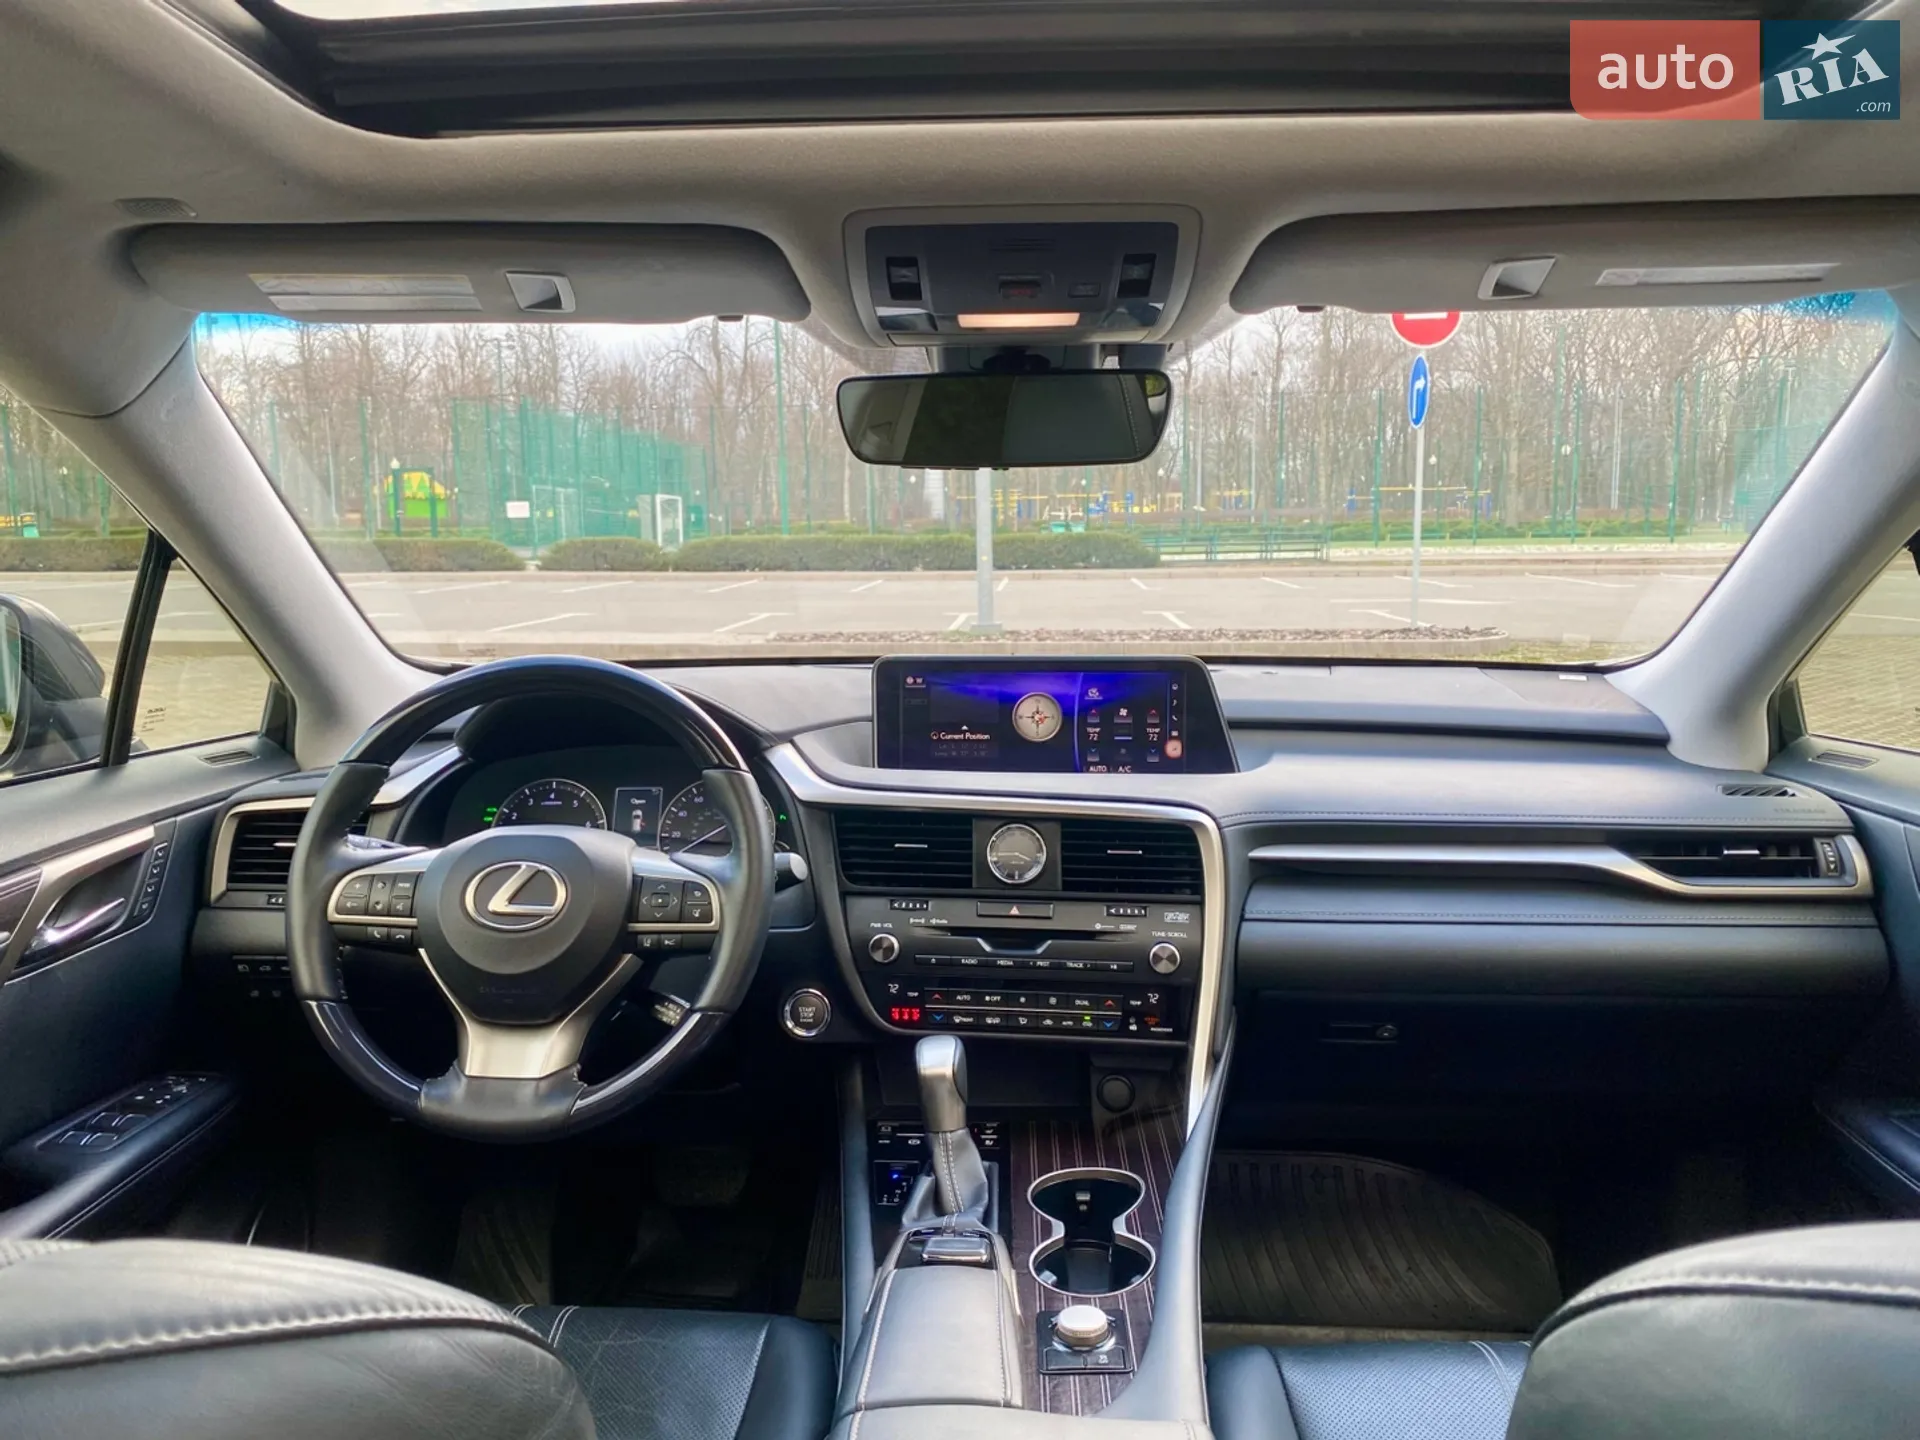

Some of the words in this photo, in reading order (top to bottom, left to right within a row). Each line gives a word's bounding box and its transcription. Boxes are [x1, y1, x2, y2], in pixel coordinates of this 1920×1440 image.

[940, 732, 964, 740] Current
[965, 732, 991, 740] Position
[1118, 765, 1132, 773] A/C
[528, 798, 534, 806] 3
[511, 812, 518, 820] 2
